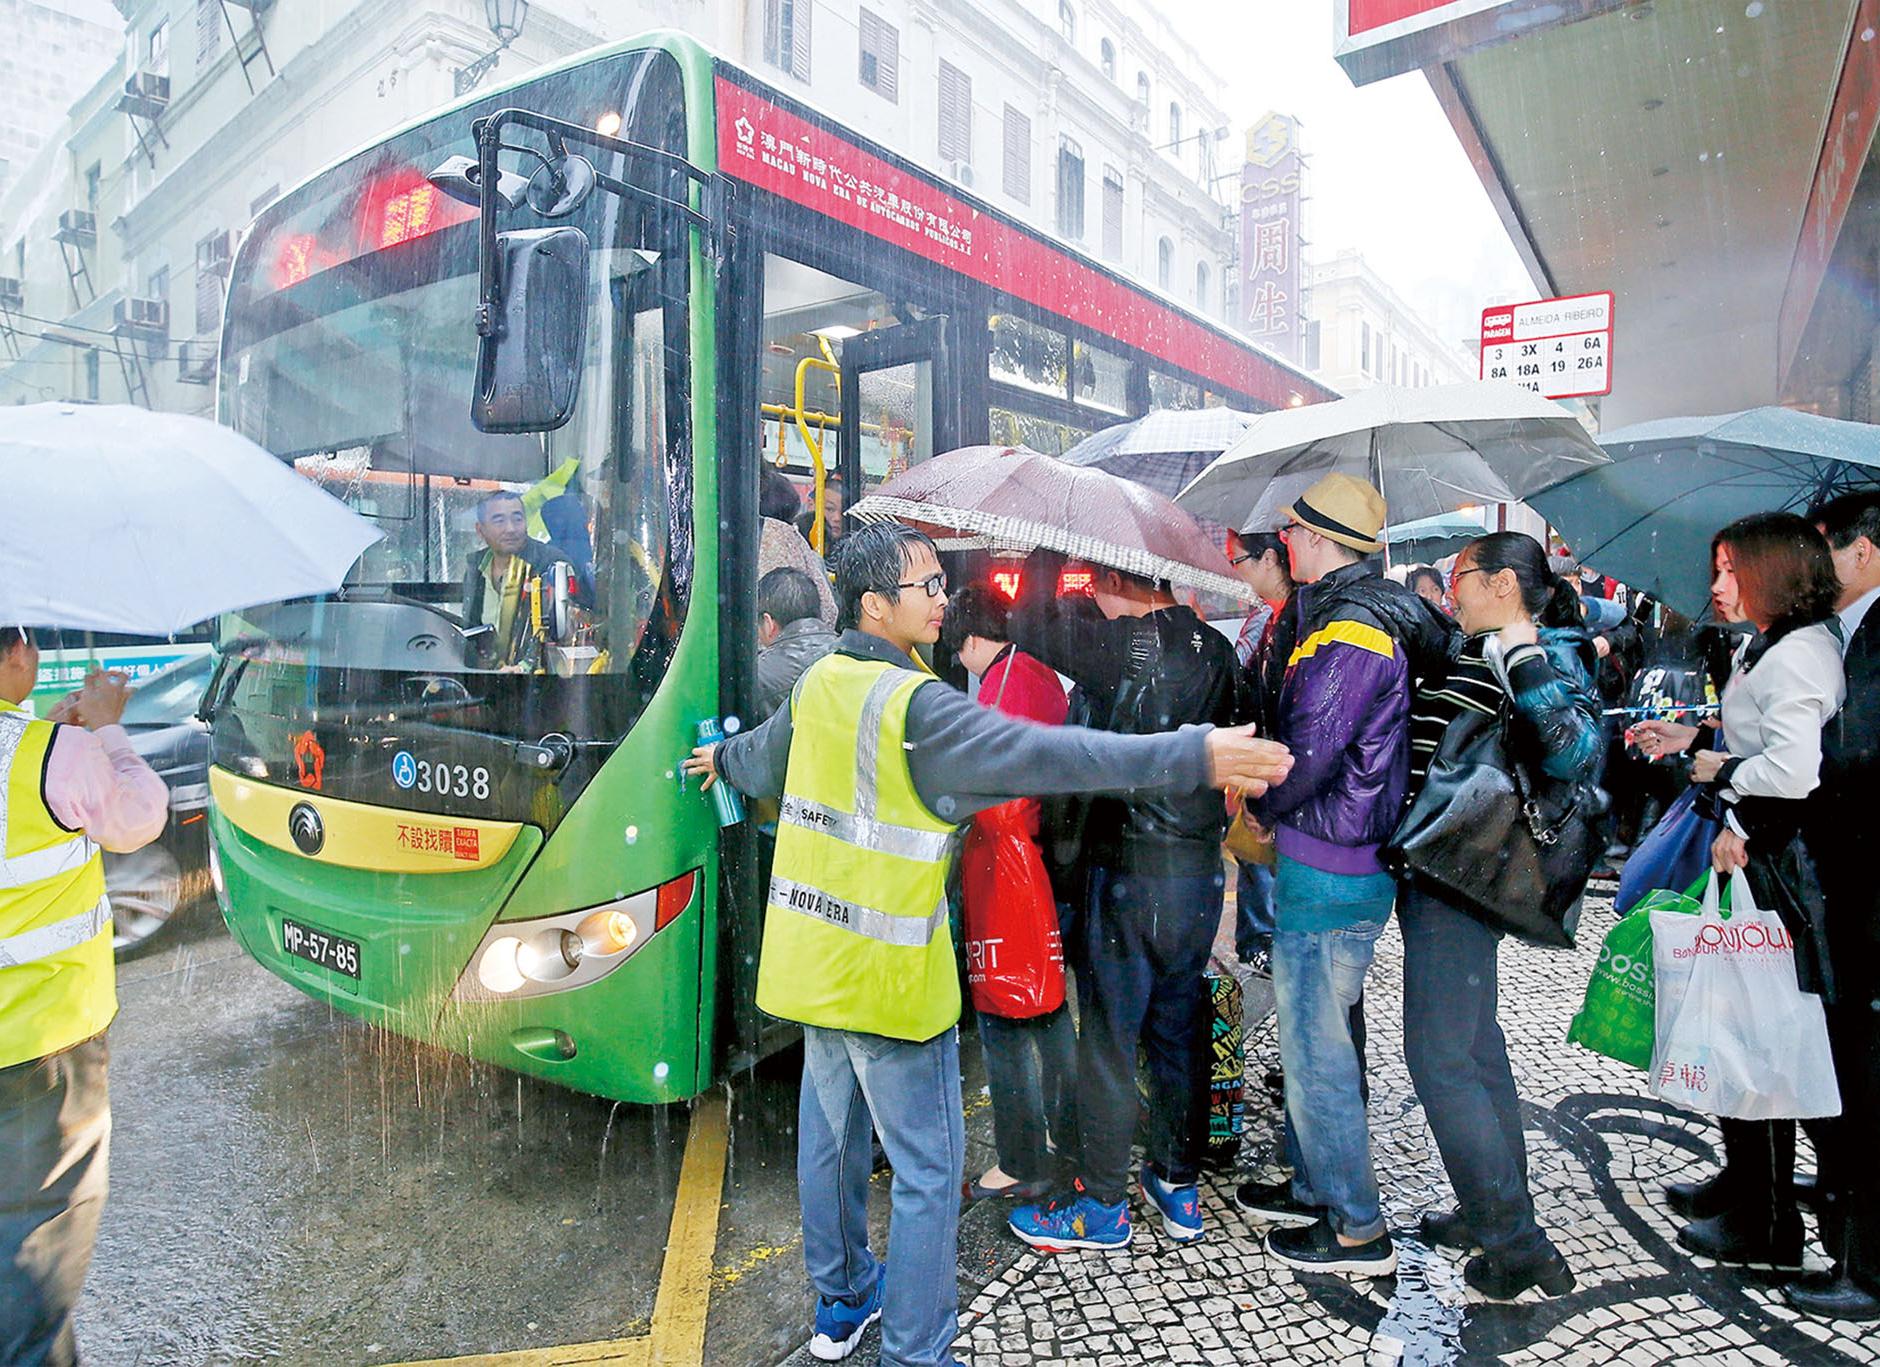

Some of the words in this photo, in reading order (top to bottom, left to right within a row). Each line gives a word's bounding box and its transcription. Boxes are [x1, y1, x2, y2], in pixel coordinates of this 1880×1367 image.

[761, 150, 796, 176] MACAU
[802, 169, 827, 191] NOVA
[832, 184, 851, 201] ERA
[1240, 171, 1300, 203] CSS
[1249, 218, 1289, 350] 周生
[1518, 313, 1560, 327] ALMEIDA
[1564, 307, 1605, 321] RIBEIRO
[1494, 348, 1503, 361] 3
[1521, 343, 1538, 357] 3X
[1555, 341, 1564, 353] 4
[1584, 337, 1601, 350] 6A
[1491, 366, 1507, 379] 8A
[1516, 363, 1541, 377] 18A
[1551, 359, 1566, 373] 19
[1577, 356, 1604, 370] 26A
[417, 760, 490, 800] 3038
[801, 808, 838, 827] SAFE
[397, 824, 454, 854] 不設找贖
[789, 888, 821, 914] NOVA
[826, 901, 849, 924] ERA
[284, 922, 358, 974] MP-57-85
